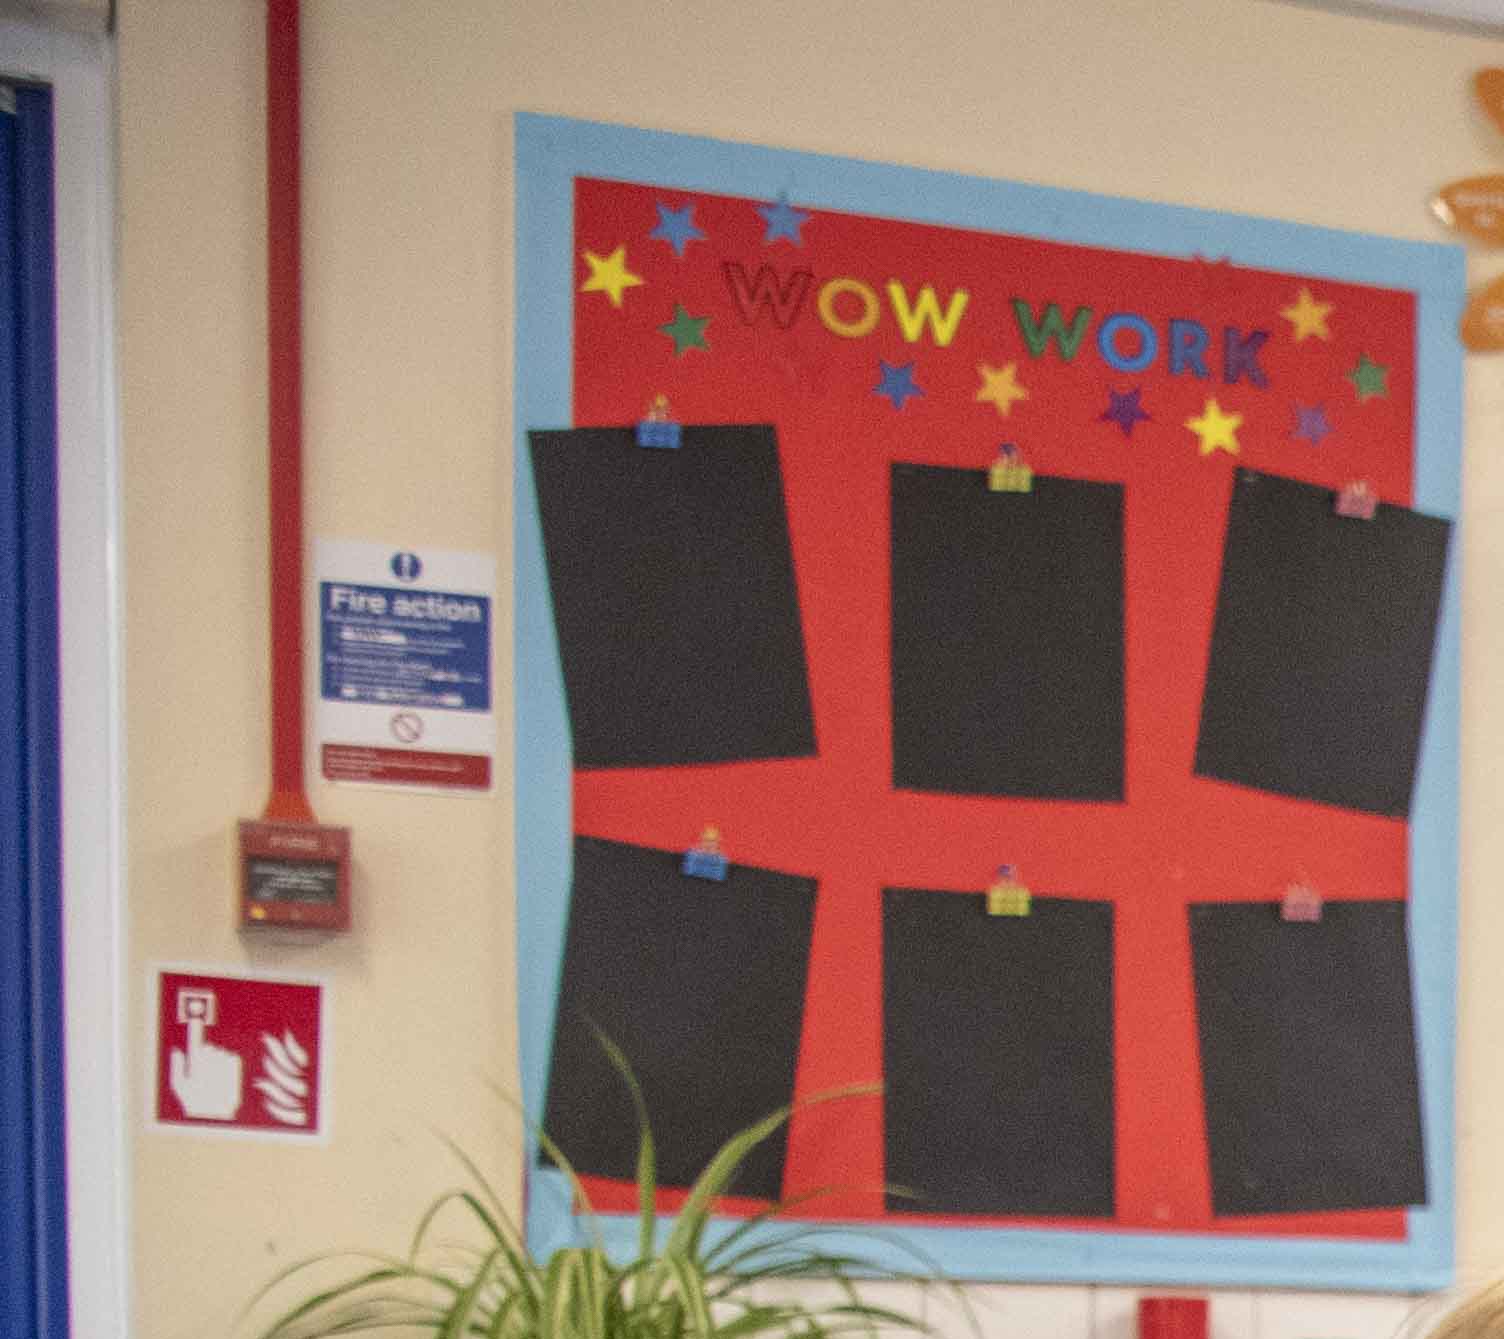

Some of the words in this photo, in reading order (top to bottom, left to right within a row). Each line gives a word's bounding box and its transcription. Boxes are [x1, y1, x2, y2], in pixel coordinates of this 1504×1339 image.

[720, 260, 970, 348] WOW
[1011, 296, 1271, 390] WORK
[329, 586, 387, 615] Fire
[393, 592, 482, 623] action
